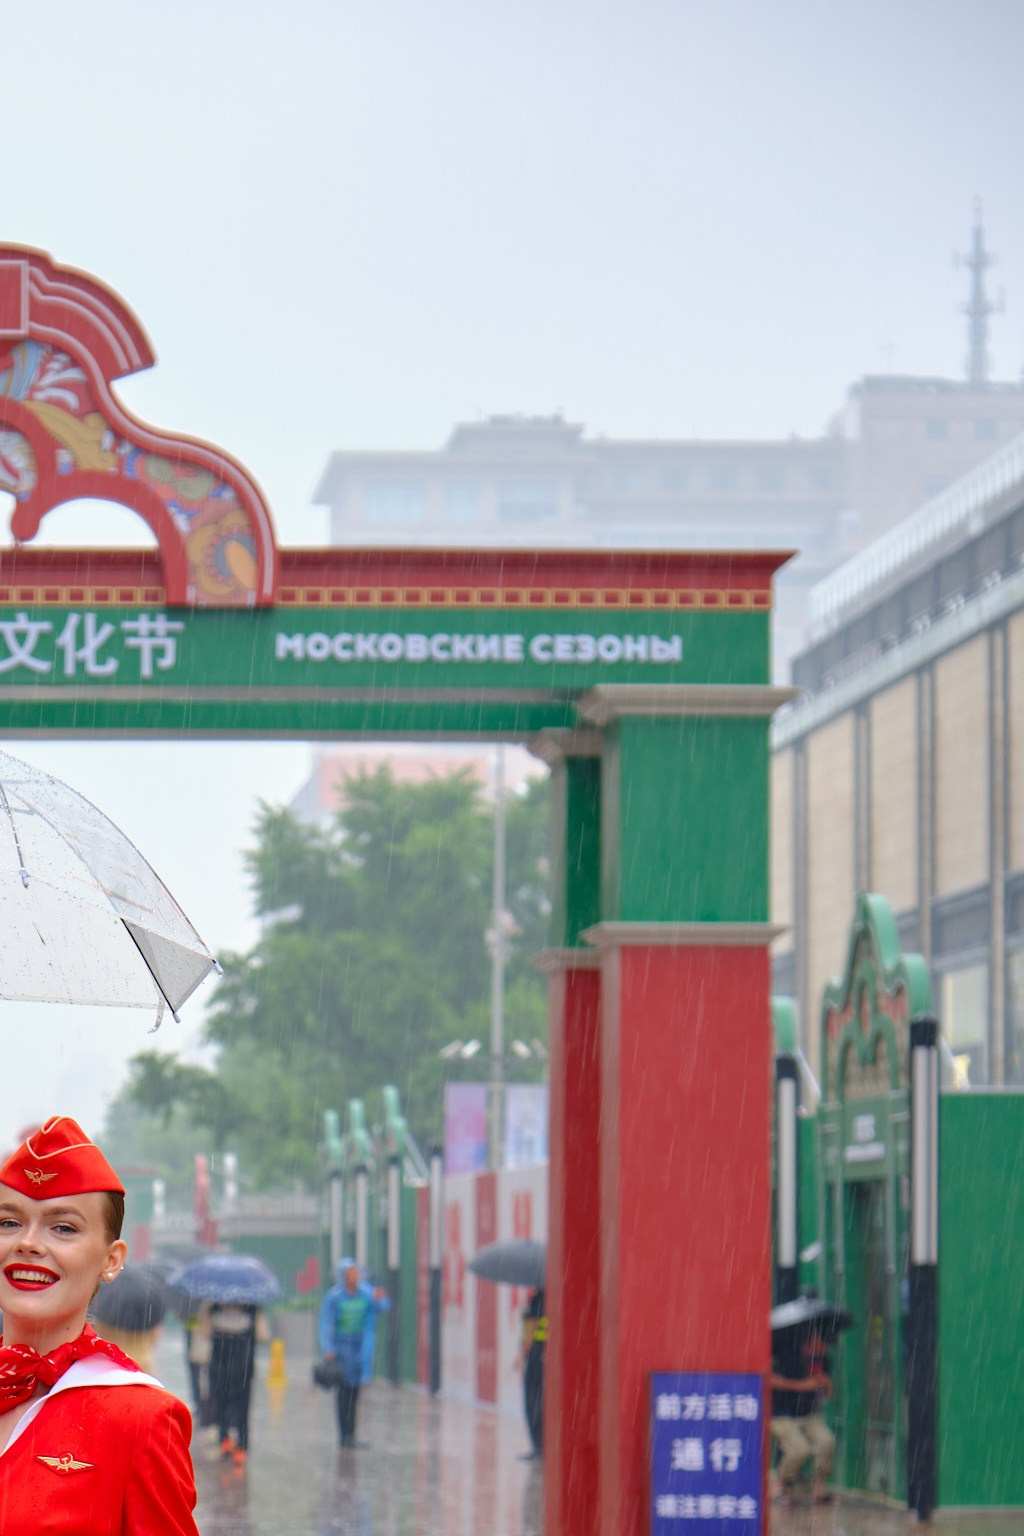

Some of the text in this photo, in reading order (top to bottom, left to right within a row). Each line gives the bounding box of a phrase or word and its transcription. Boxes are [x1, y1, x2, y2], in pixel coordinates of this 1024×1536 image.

[275, 632, 683, 662] МОСКОВСКИЕ СЕЗОНЫ
[655, 1392, 759, 1421] 前方活动
[671, 1437, 742, 1472] 通行
